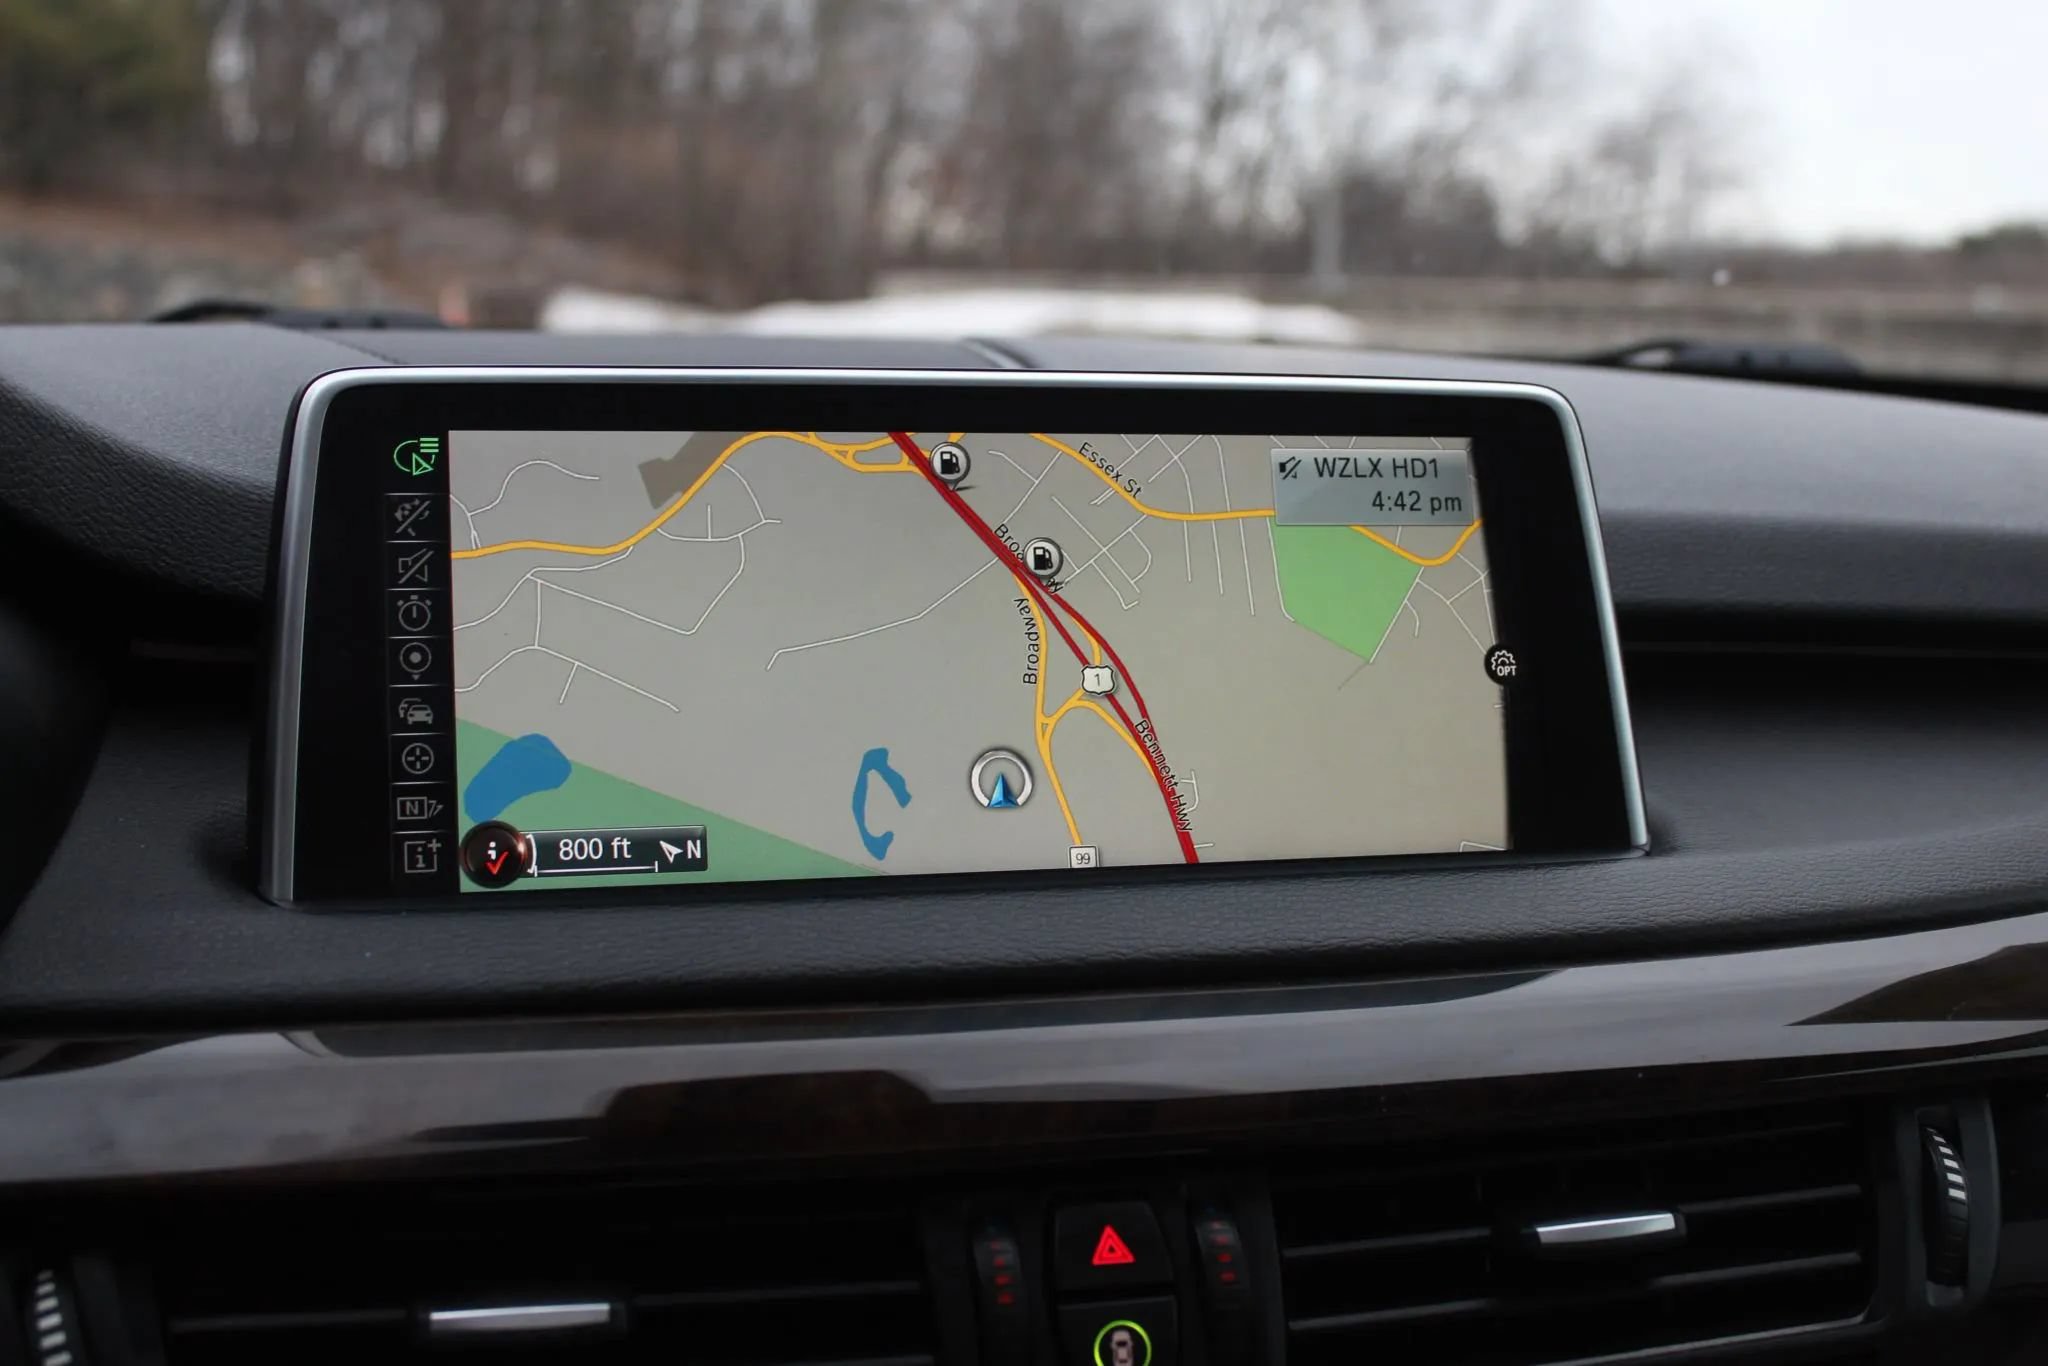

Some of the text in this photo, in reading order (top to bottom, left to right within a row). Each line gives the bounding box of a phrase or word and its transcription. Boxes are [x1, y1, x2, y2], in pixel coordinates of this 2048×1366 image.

[1078, 442, 1142, 499] Essex St
[1313, 457, 1440, 479] WZLX HD1
[1371, 490, 1463, 516] 4:42 pm
[1014, 597, 1040, 685] Broadway
[1093, 673, 1101, 687] 1
[1496, 665, 1517, 677] OPT
[1134, 719, 1193, 832] Bennett Hwy
[405, 801, 420, 815] N
[558, 836, 632, 861] 800 ft
[686, 839, 702, 859] N
[1075, 853, 1091, 866] 99
